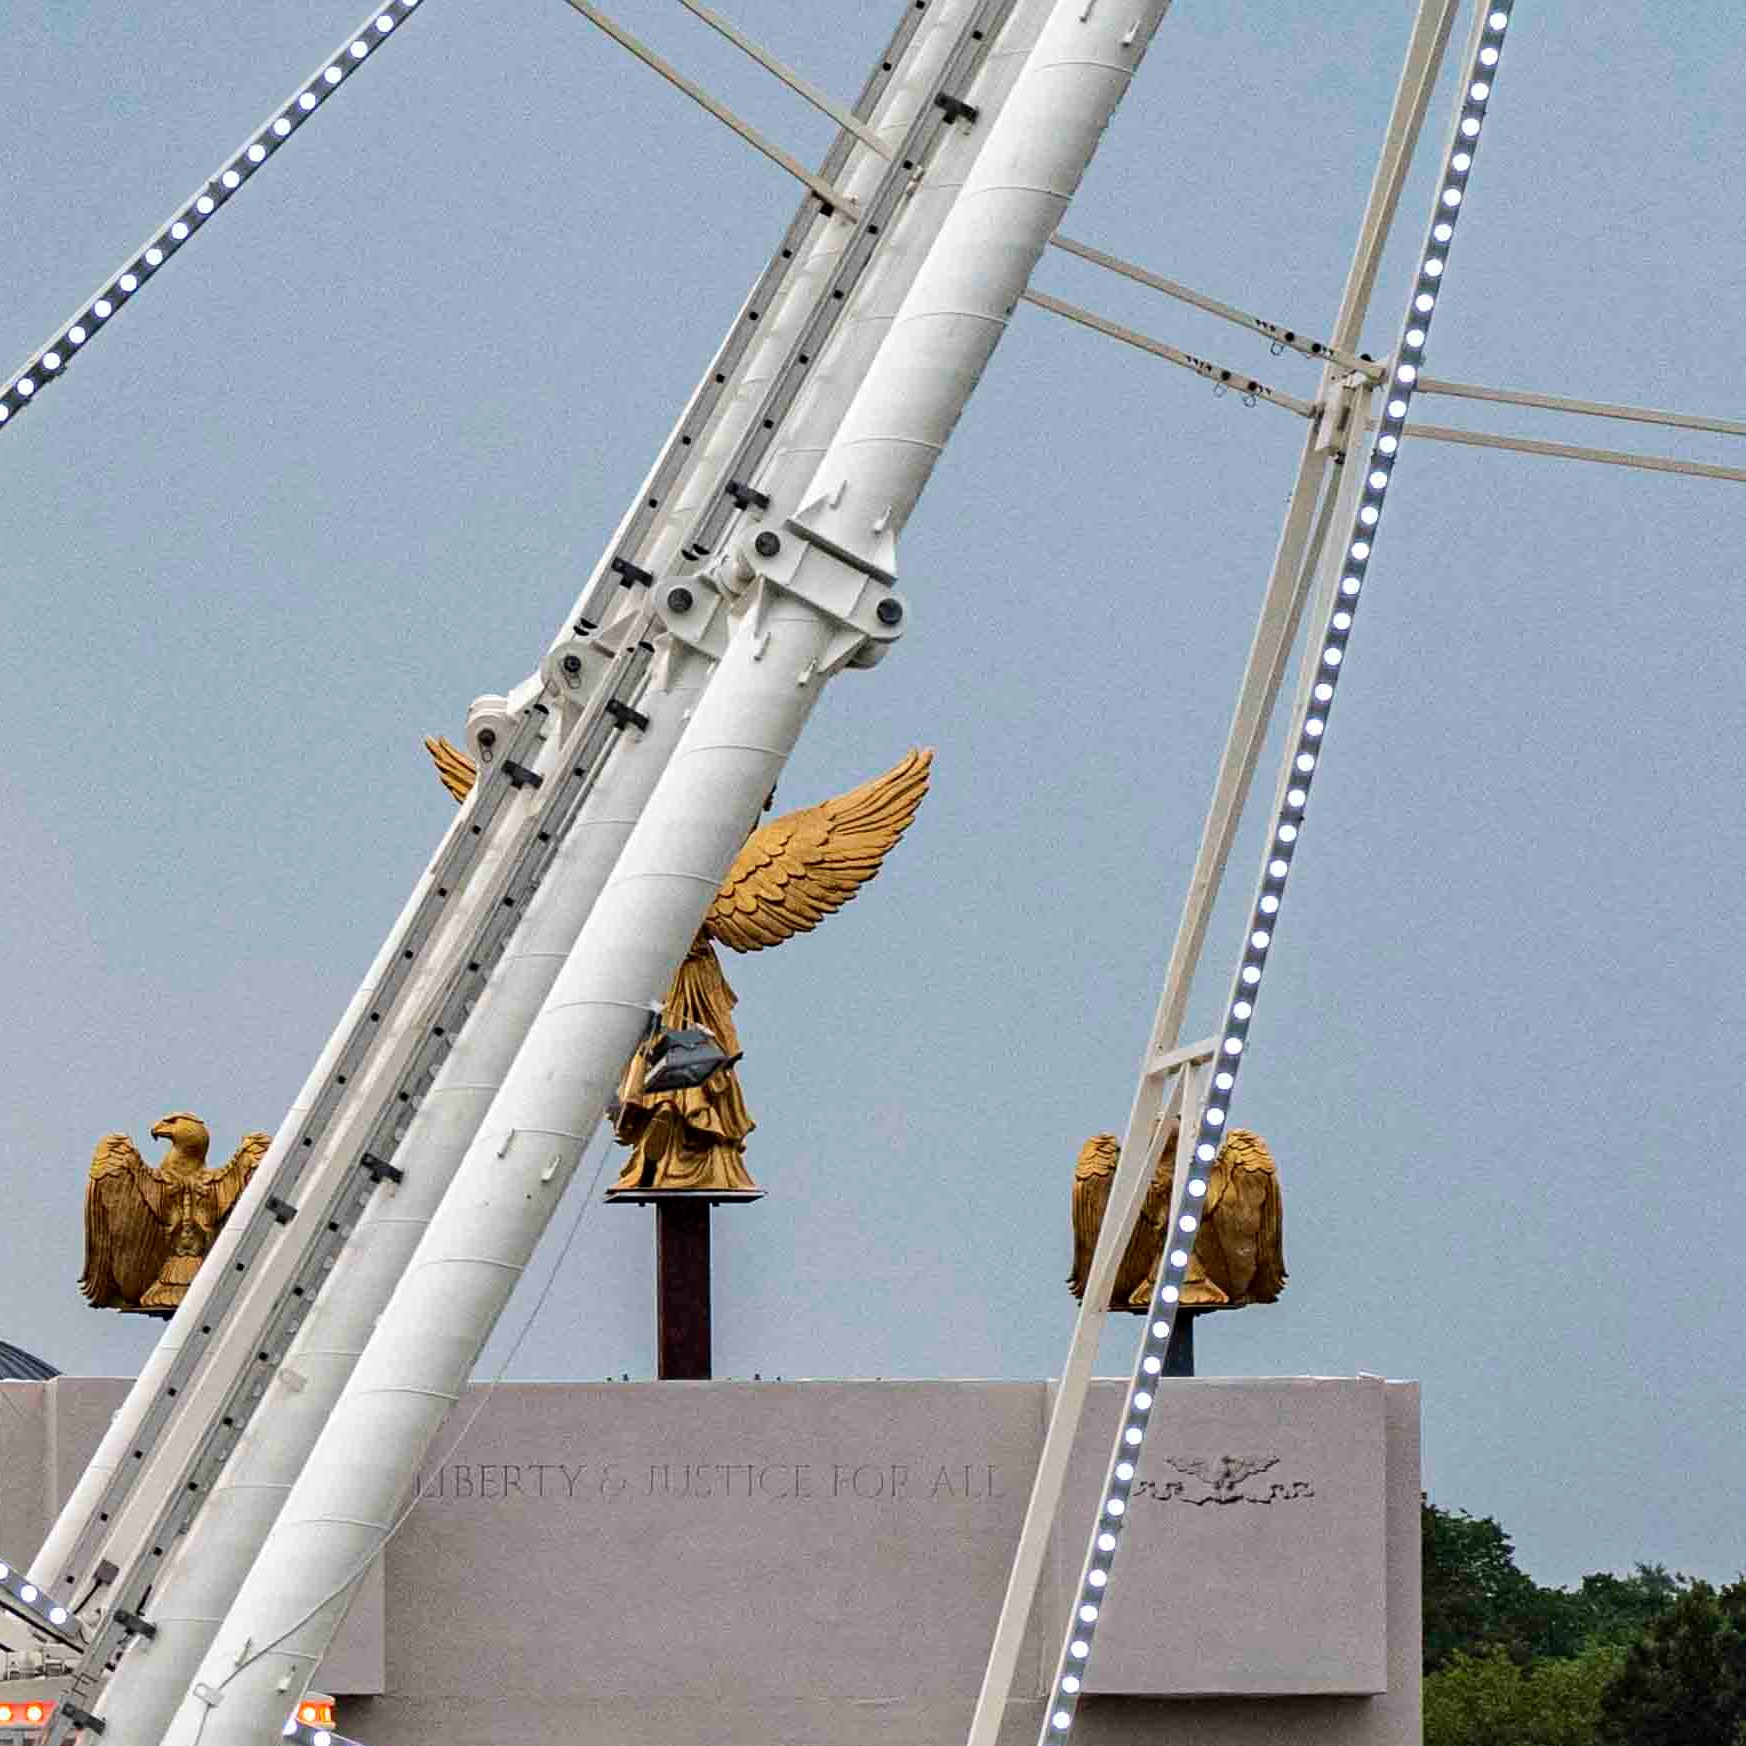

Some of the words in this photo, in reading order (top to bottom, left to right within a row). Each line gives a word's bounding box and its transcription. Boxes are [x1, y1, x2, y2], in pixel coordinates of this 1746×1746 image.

[411, 1463, 587, 1498] LIBERTY
[641, 1463, 812, 1499] JUSTICE
[832, 1463, 908, 1499] FOR
[930, 1463, 1008, 1498] ALL
